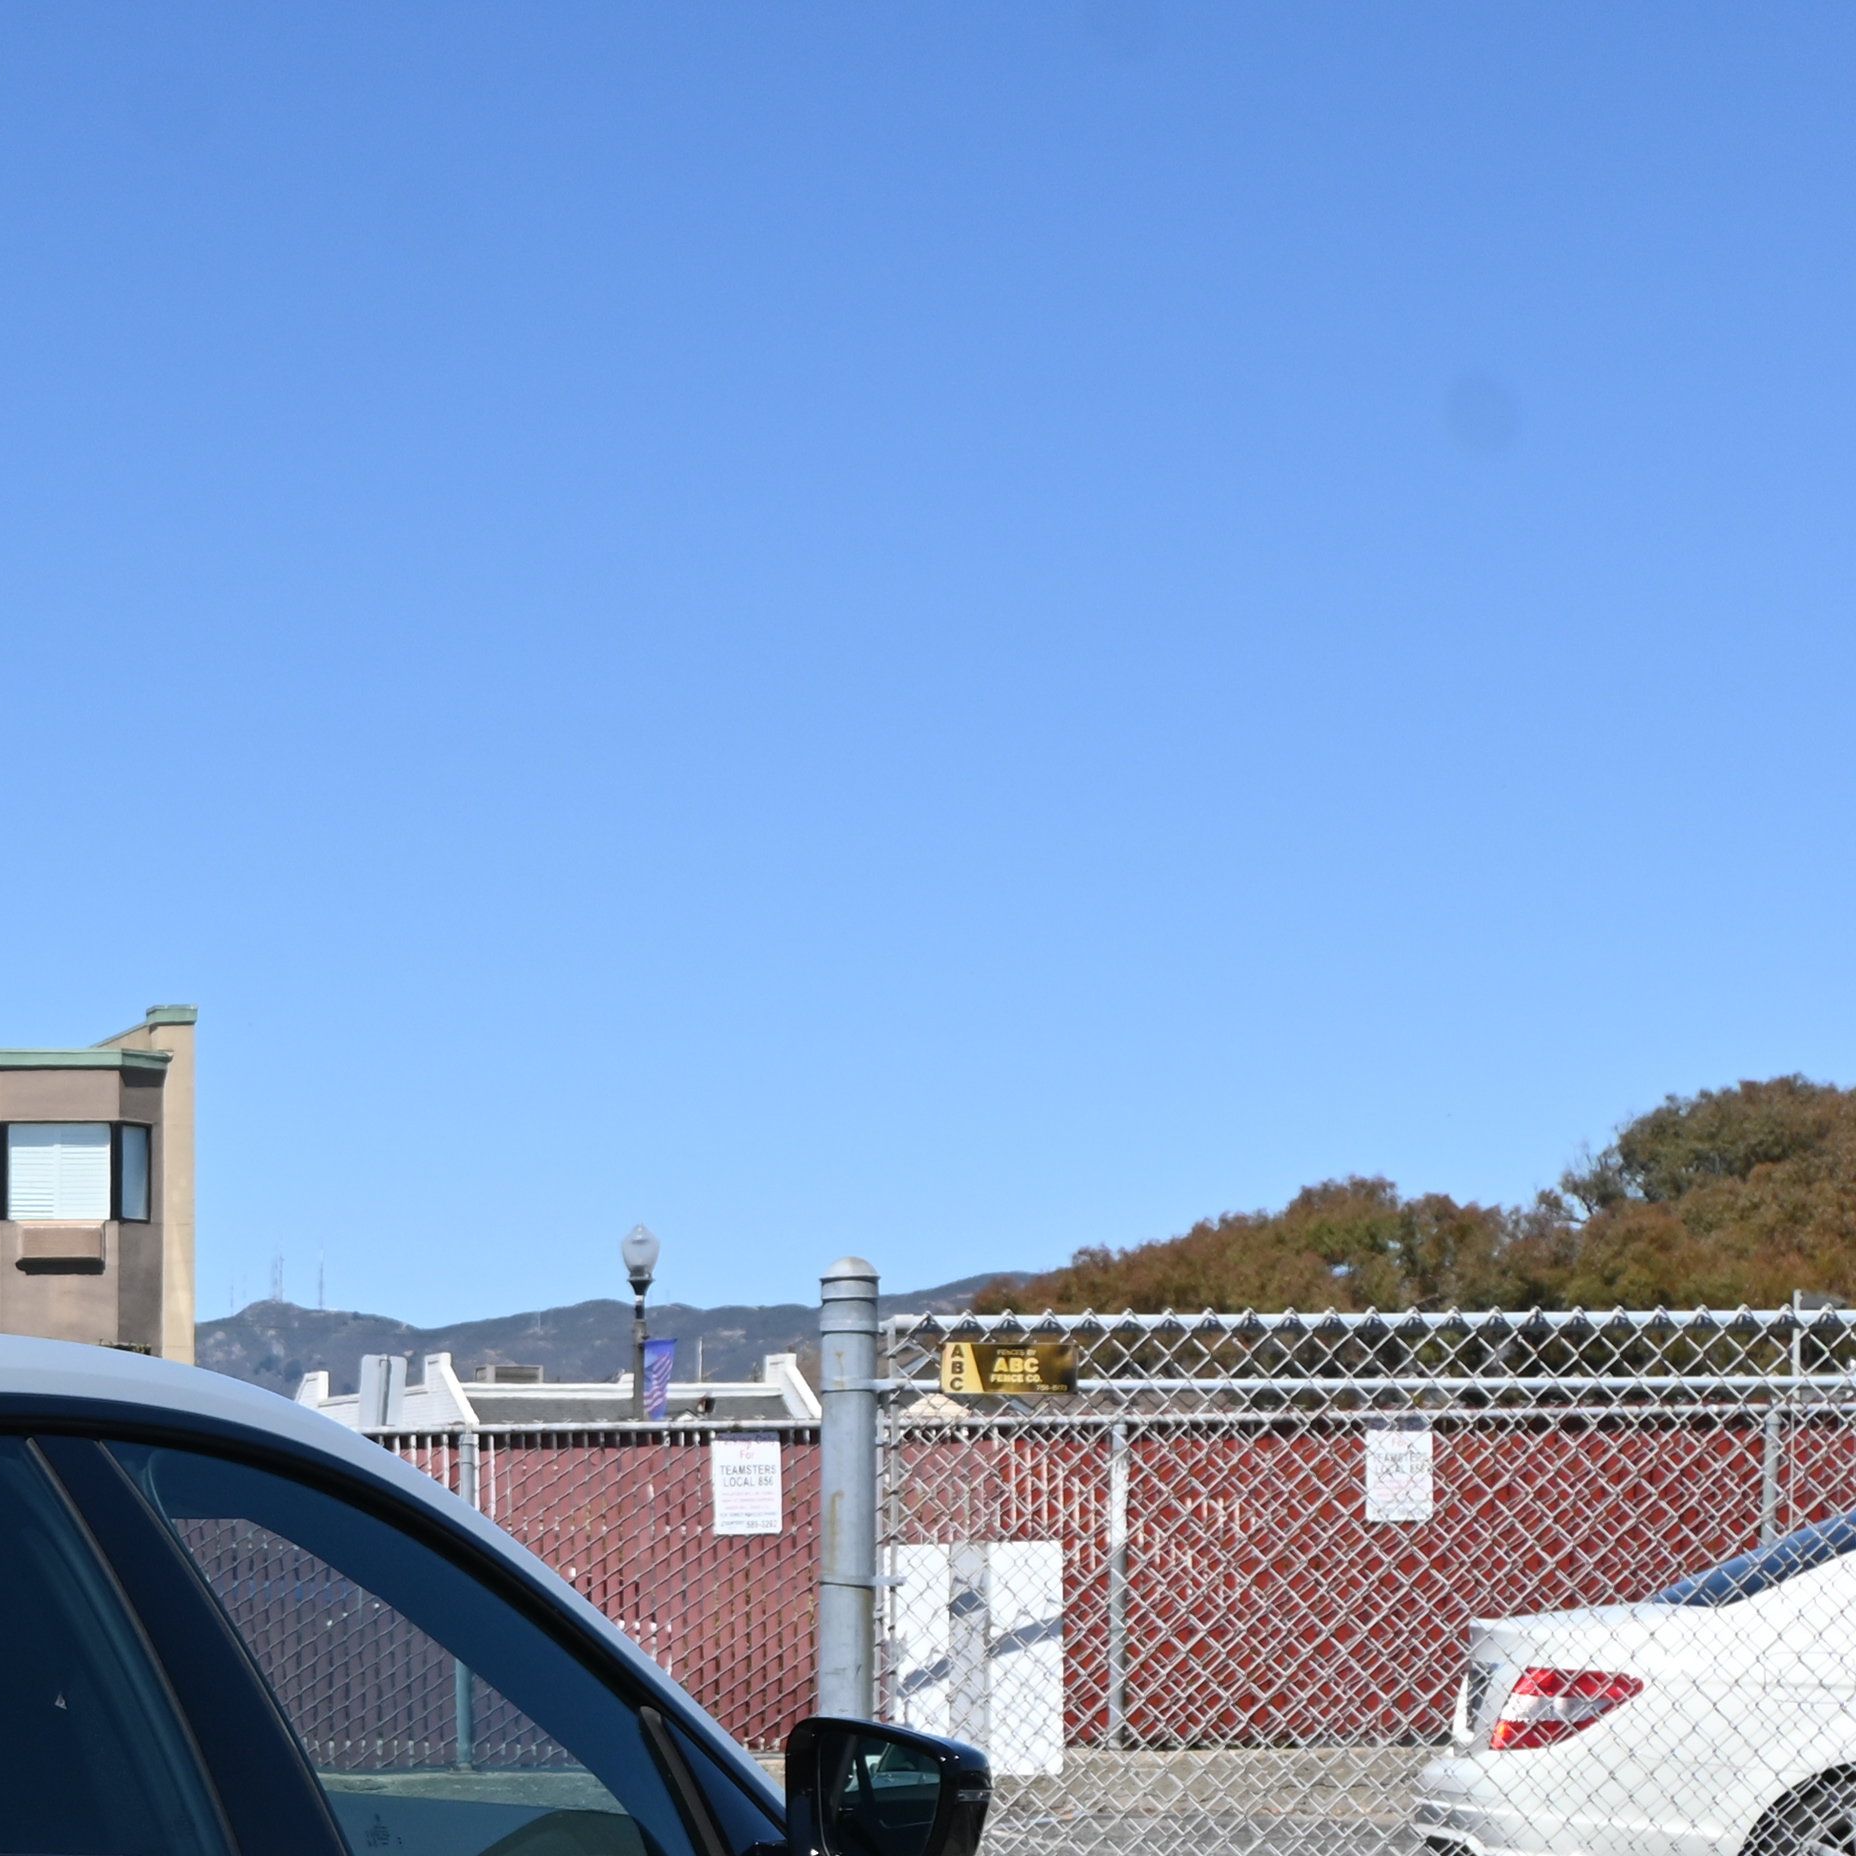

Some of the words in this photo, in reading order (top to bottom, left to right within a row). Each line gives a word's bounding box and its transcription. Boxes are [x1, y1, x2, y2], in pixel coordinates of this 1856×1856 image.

[993, 1356, 1039, 1373] ABC
[990, 1373, 1024, 1383] FENCE
[719, 1464, 776, 1476] TEAMSTERS
[723, 1476, 755, 1487] LOCAL
[758, 1477, 774, 1487] 856
